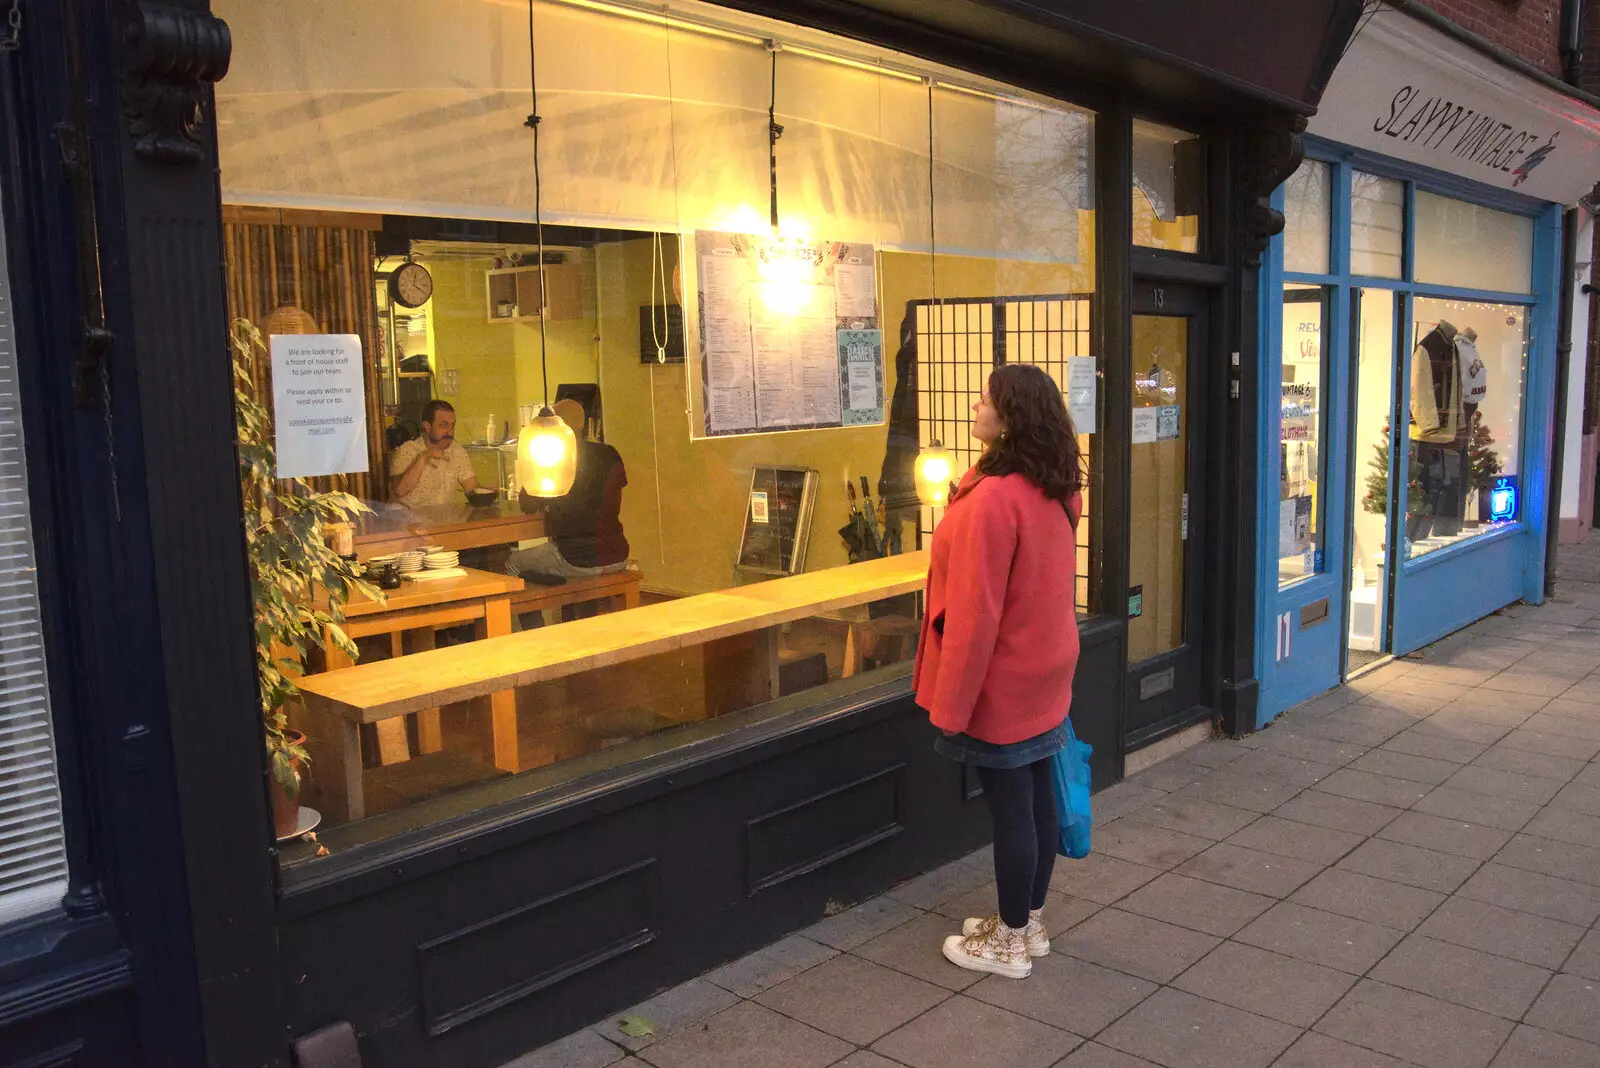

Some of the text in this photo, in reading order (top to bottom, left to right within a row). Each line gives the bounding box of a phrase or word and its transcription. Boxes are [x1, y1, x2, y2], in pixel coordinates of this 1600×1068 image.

[1373, 86, 1538, 172] SLAYYY VINTAGE
[1153, 288, 1164, 308] 13
[312, 348, 335, 358] looking
[847, 345, 875, 361] RAMEN
[307, 357, 315, 366] of
[335, 356, 349, 364] staff
[300, 368, 313, 377] join
[286, 386, 352, 398] Please apply within or
[296, 397, 311, 405] send
[311, 397, 325, 406] your
[1276, 610, 1291, 662] 11
